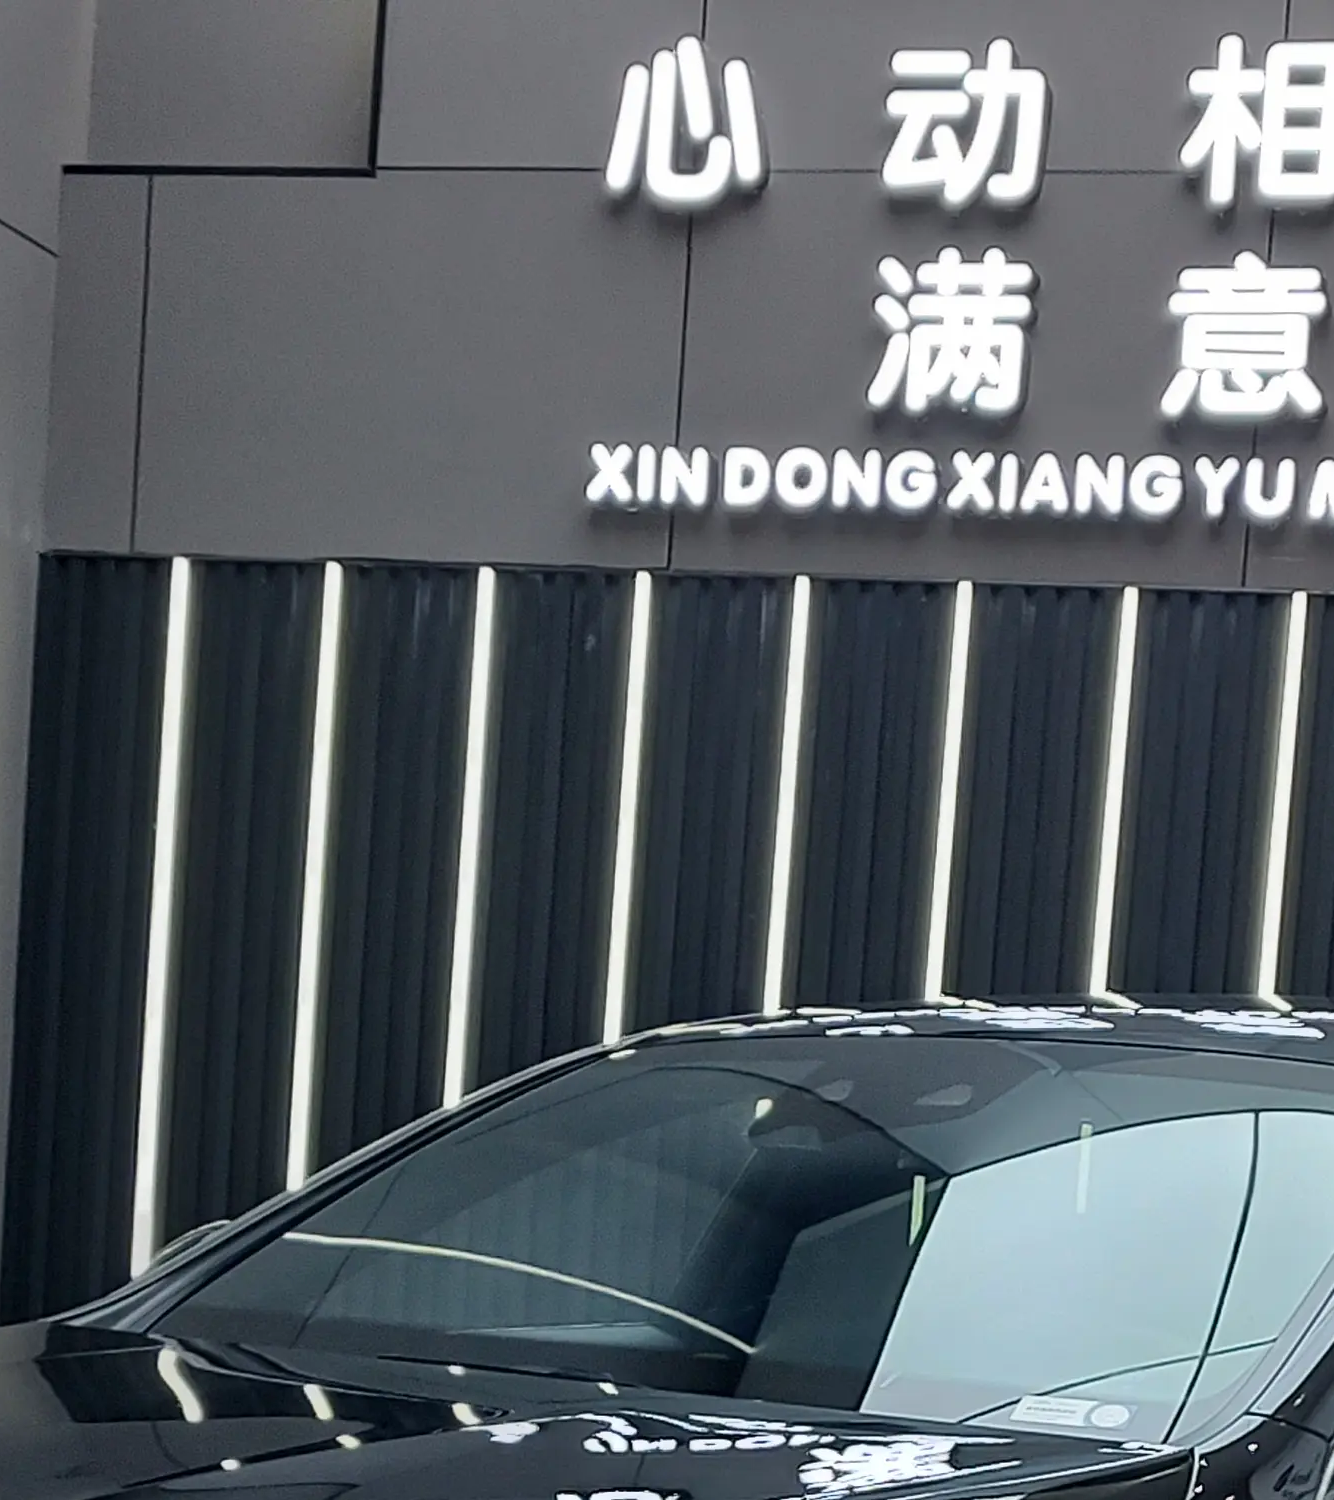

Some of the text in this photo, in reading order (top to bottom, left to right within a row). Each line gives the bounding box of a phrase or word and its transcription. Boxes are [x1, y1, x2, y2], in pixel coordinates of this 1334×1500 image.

[585, 443, 710, 506] XIN
[723, 446, 938, 510] DONG
[946, 450, 1183, 516] XIANG
[1194, 456, 1296, 520] YU
